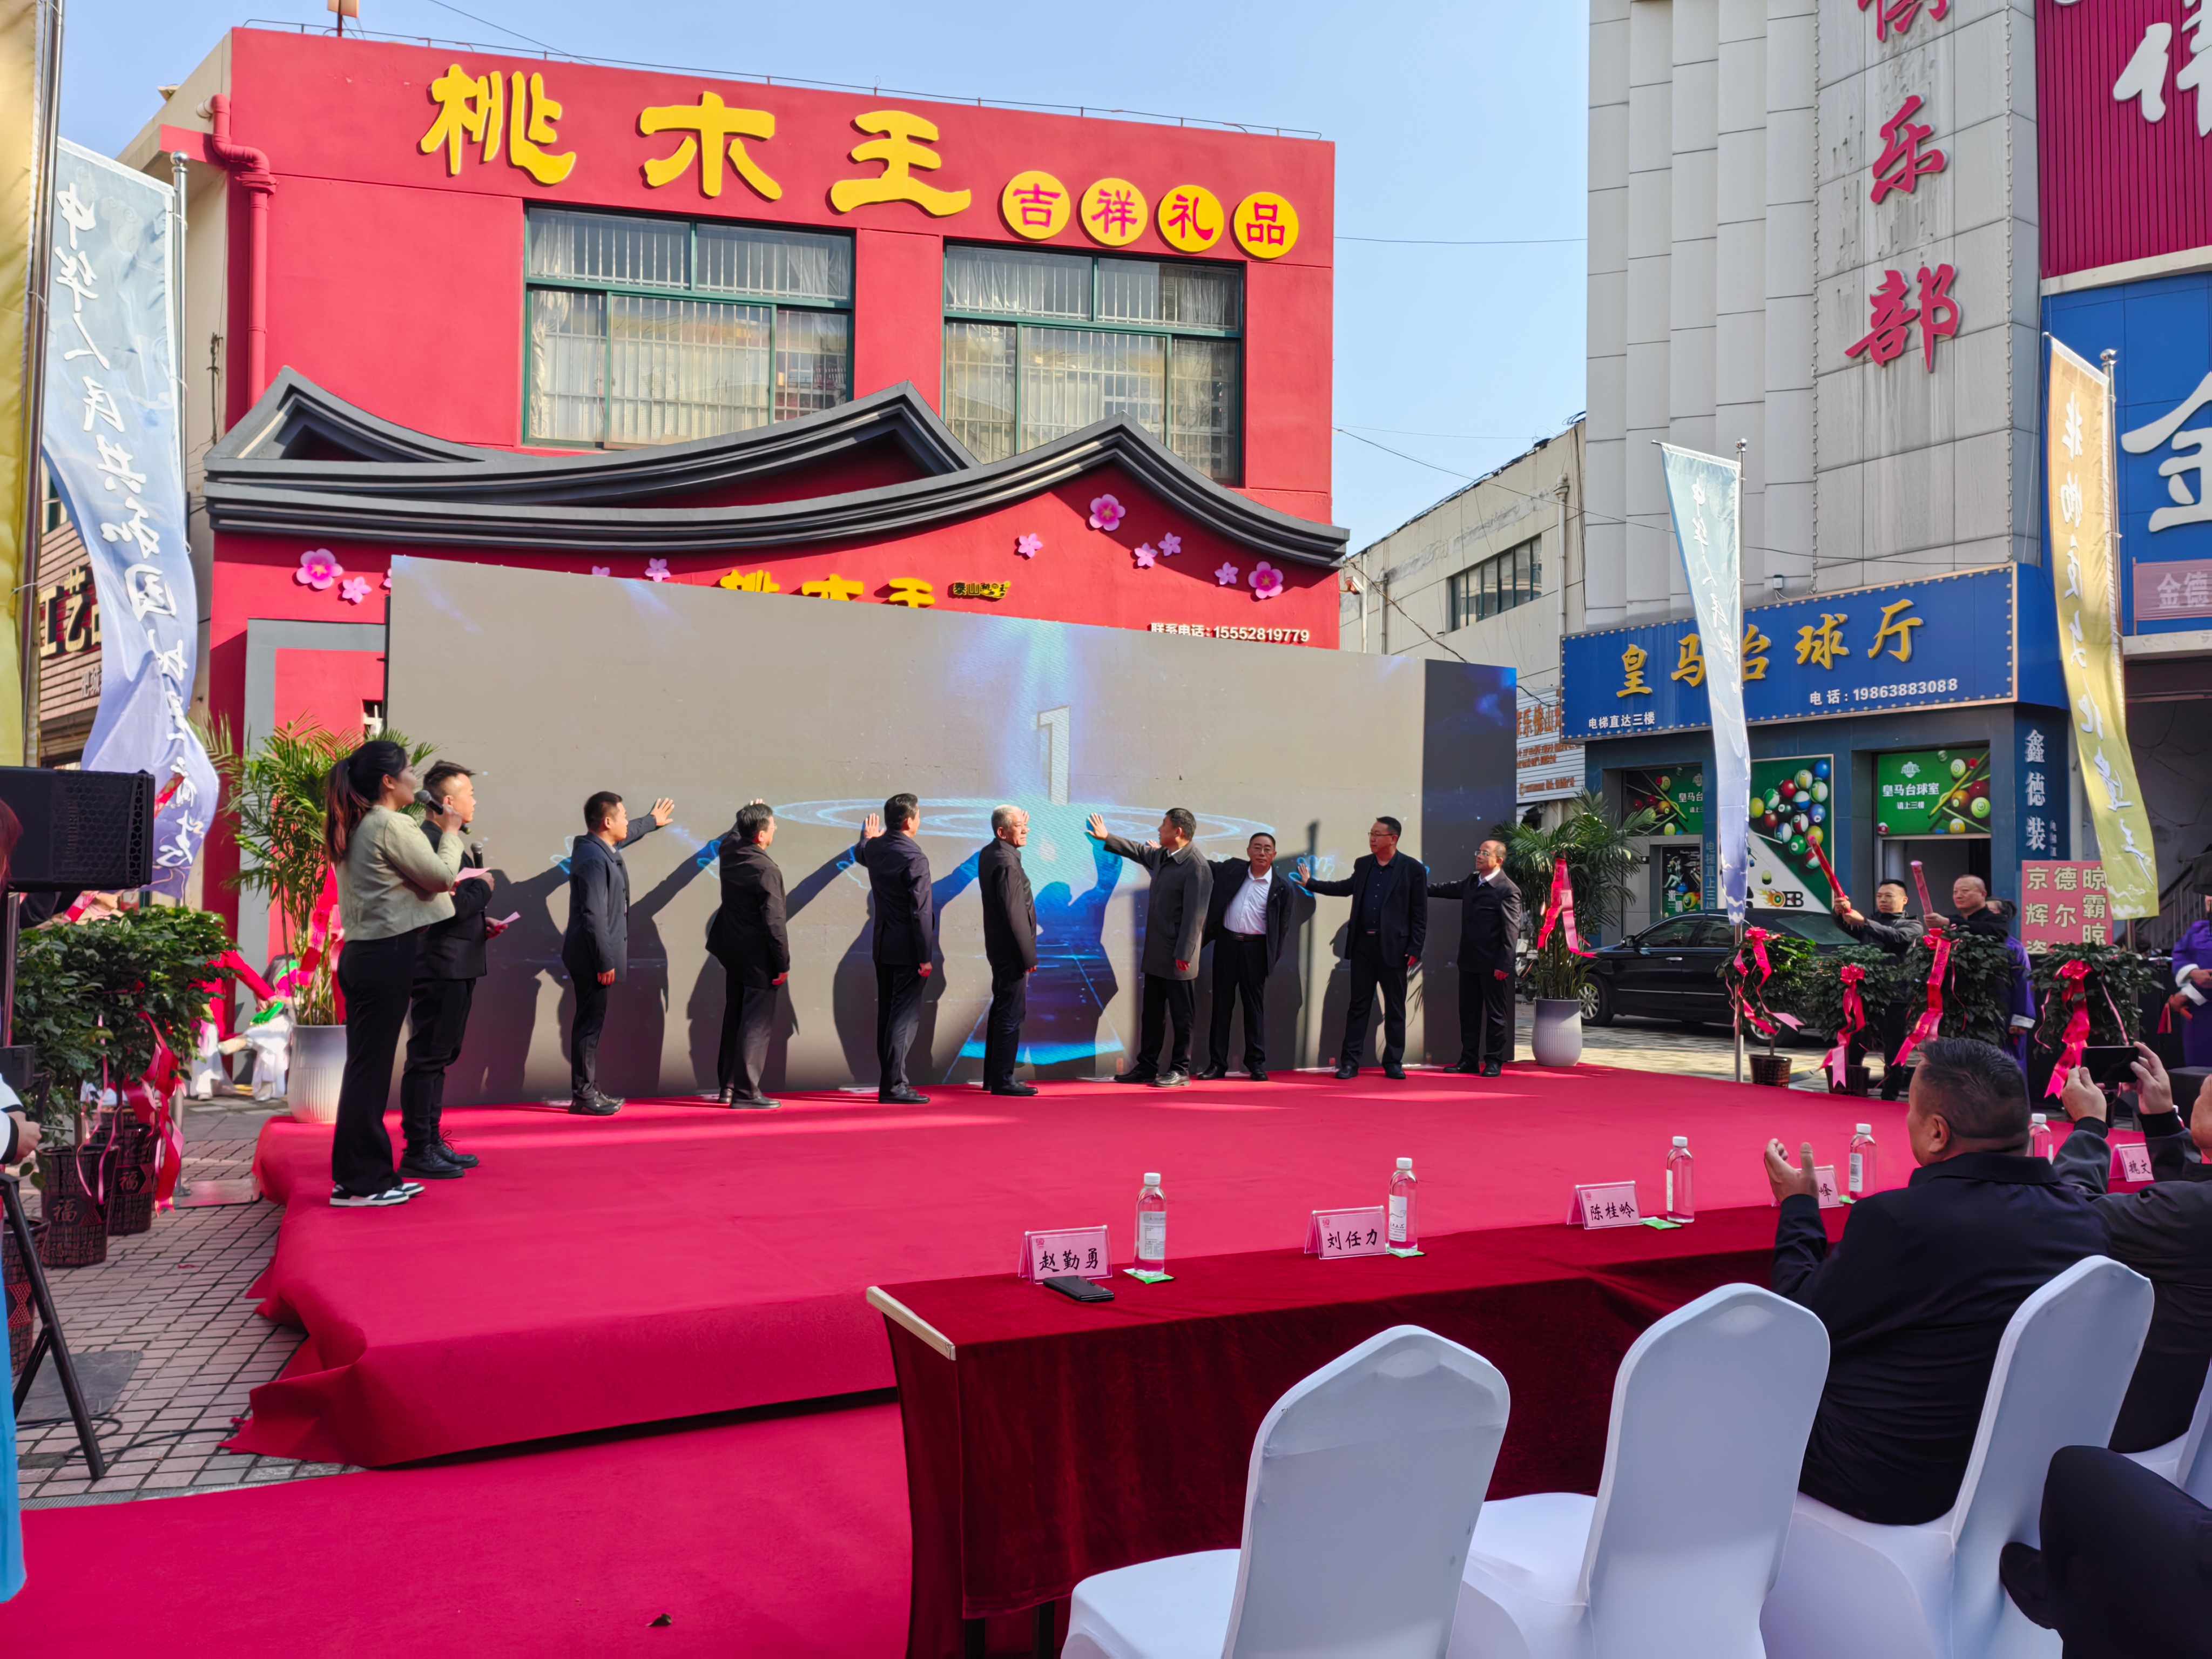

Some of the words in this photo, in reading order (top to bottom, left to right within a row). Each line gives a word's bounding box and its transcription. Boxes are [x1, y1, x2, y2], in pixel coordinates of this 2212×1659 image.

[420, 63, 971, 216] 桃木王
[1013, 183, 1286, 246] 吉祥礼品
[1845, 0, 1961, 373] 乐部
[39, 565, 100, 658] 工艺
[1616, 599, 1924, 699] 皇马台球厅
[1037, 705, 1071, 806] 1
[1588, 711, 1656, 730] 电梯直达三楼
[1882, 783, 1940, 797] 皇马台球室
[2054, 866, 2078, 945] 德尔
[1038, 1247, 1098, 1272] 赵勤勇
[1327, 1228, 1378, 1251] 刘任力
